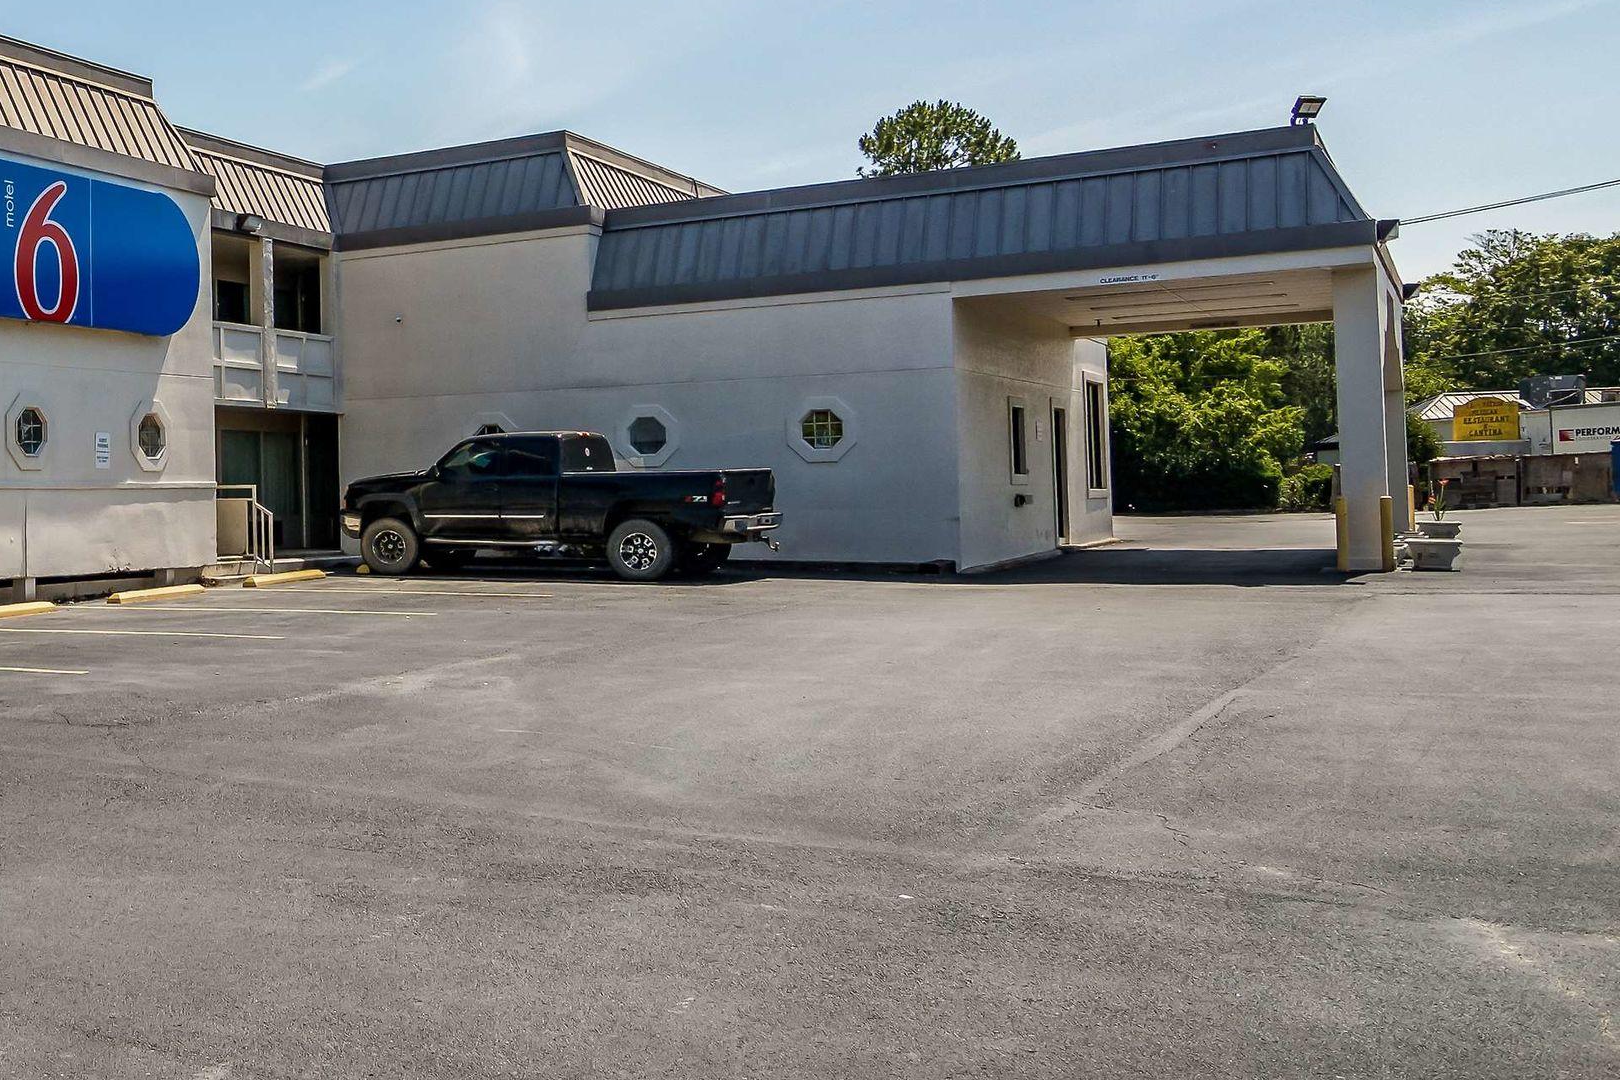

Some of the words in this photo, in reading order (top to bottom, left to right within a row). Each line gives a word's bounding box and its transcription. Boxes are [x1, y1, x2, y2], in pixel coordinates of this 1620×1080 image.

[4, 179, 14, 228] motel
[14, 180, 79, 323] 6
[1100, 275, 1140, 284] CLEARANCE
[1463, 415, 1509, 424] RESTAURANT
[1468, 428, 1502, 436] CANTINA
